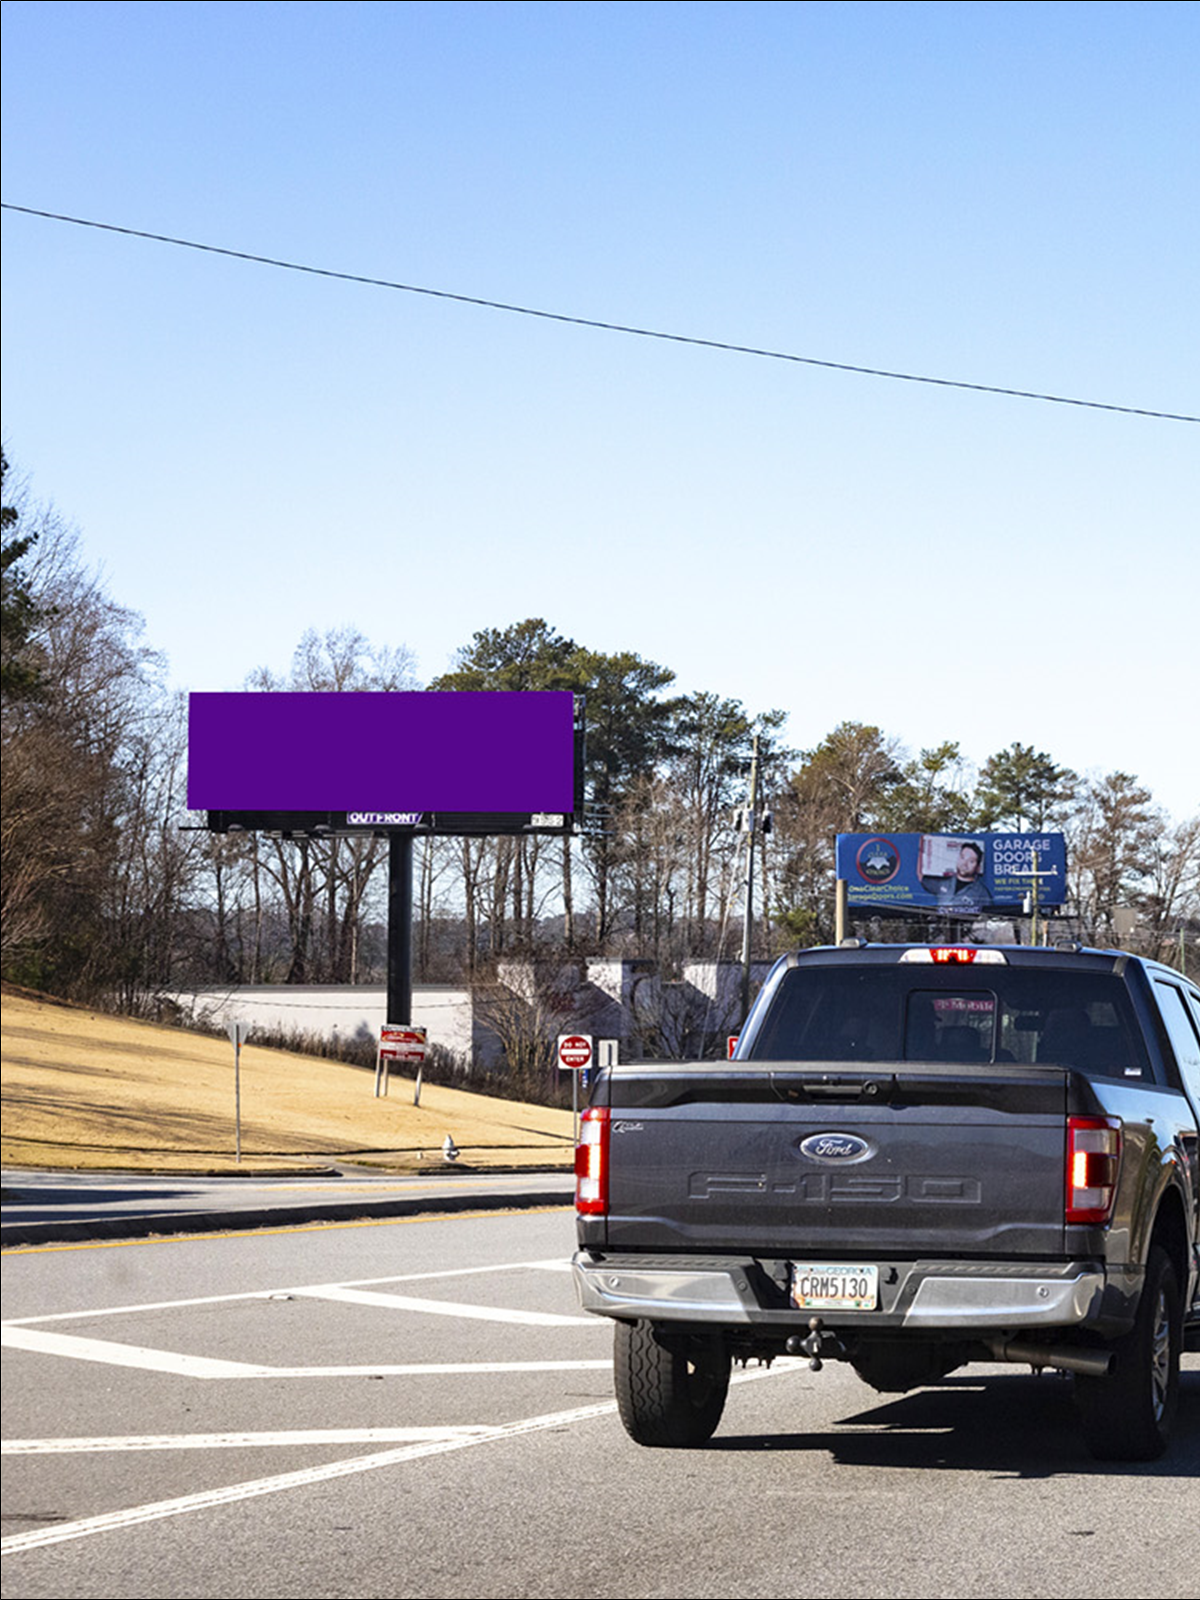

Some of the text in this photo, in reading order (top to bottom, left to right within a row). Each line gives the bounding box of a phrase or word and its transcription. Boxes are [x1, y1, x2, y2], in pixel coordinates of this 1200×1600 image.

[350, 812, 420, 823] OUTFRONT
[993, 839, 1051, 851] GARAGE
[994, 852, 1042, 863] DOORS
[994, 864, 1037, 875] BREA
[848, 884, 909, 893] OneClearChoice
[815, 1139, 853, 1155] Ford
[688, 1171, 981, 1204] F-150
[801, 1276, 868, 1299] CRM5130
